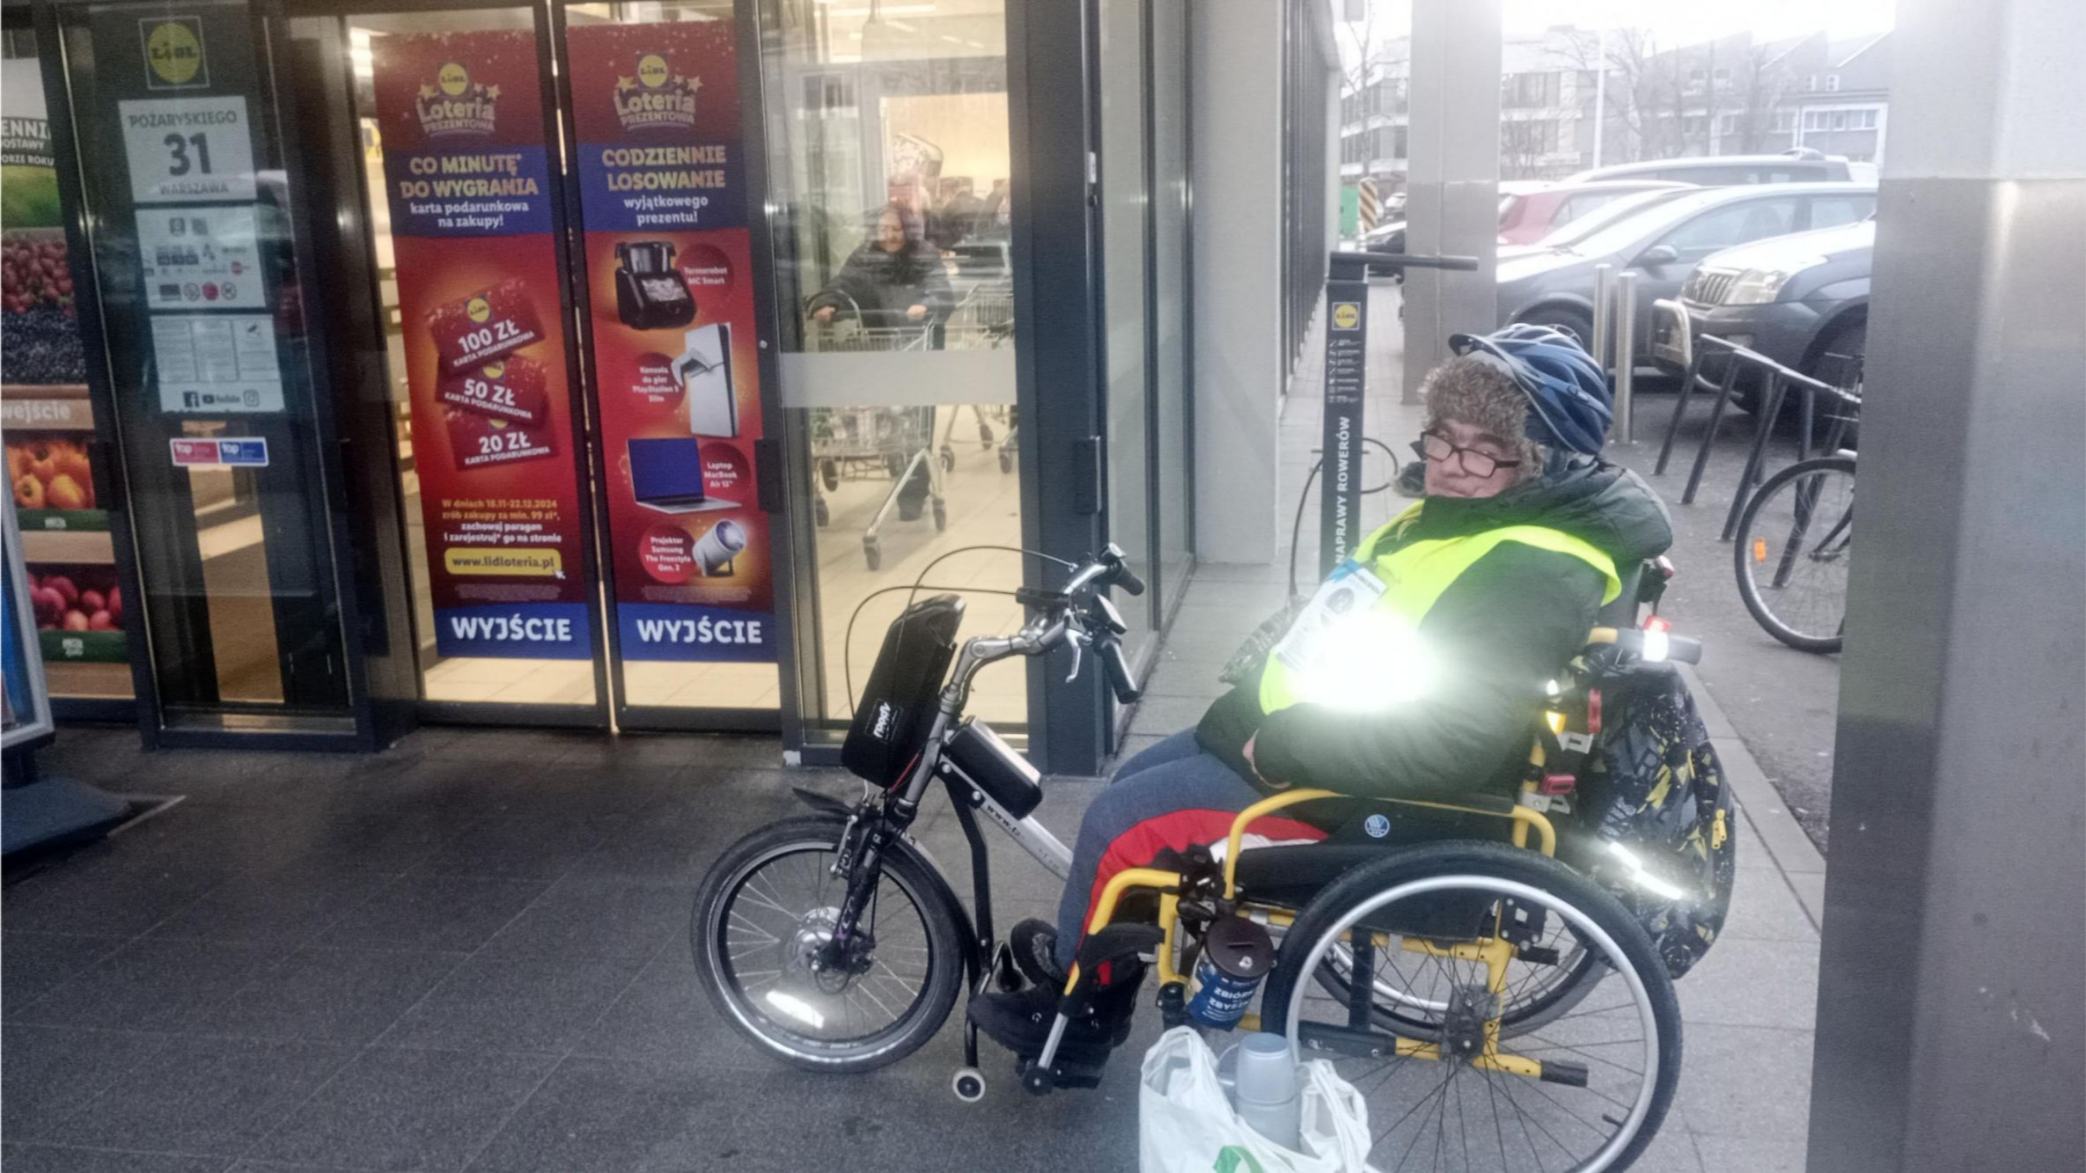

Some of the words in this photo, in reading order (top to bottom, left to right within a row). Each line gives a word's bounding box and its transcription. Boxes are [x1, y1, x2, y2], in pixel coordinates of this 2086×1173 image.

[416, 97, 496, 122] Loteria
[613, 89, 696, 116] Loteria
[424, 120, 496, 133] PREZENTOWA
[620, 111, 695, 126] PREZENTOWA
[1, 119, 51, 140] ENNI
[164, 133, 211, 176] 31
[602, 146, 726, 167] CODZIENNIE
[410, 158, 437, 174] CO
[161, 183, 229, 195] WARSZAWA
[402, 181, 430, 198] DO
[433, 178, 539, 197] WYGRANIA
[607, 170, 726, 191] LOSOWANIE
[410, 203, 442, 214] karta
[445, 200, 529, 215] podarunkowa
[624, 195, 708, 211] wyjątkowego
[438, 218, 453, 228] na
[456, 216, 504, 229] zakupy!
[636, 211, 698, 226] prezentu!
[458, 328, 492, 353] 100
[494, 319, 520, 340] ZŁ
[453, 353, 477, 367] KARTA
[478, 331, 535, 358] PODARUNKOWA
[464, 379, 487, 398] 50
[492, 385, 516, 406] ZŁ
[444, 392, 469, 404] KARTA
[471, 398, 533, 420] PODARUNKOWA
[479, 435, 503, 454] 20
[506, 431, 531, 449] ZŁ
[465, 453, 490, 465] KARTA
[490, 446, 550, 461] PODARUNKOWA
[1336, 416, 1350, 493] ROWERÓW
[442, 500, 452, 508] W
[453, 499, 485, 508] dniach
[464, 512, 496, 521] zakupy
[504, 523, 542, 532] paragon
[1336, 495, 1348, 564] NAPRAWY
[503, 534, 515, 544] go
[517, 534, 529, 542] na
[530, 533, 562, 542] stronie
[452, 556, 554, 570] www.lidloteria.pl
[451, 614, 572, 641] WYJŚCIE
[636, 616, 762, 644] WYJŚCIE
